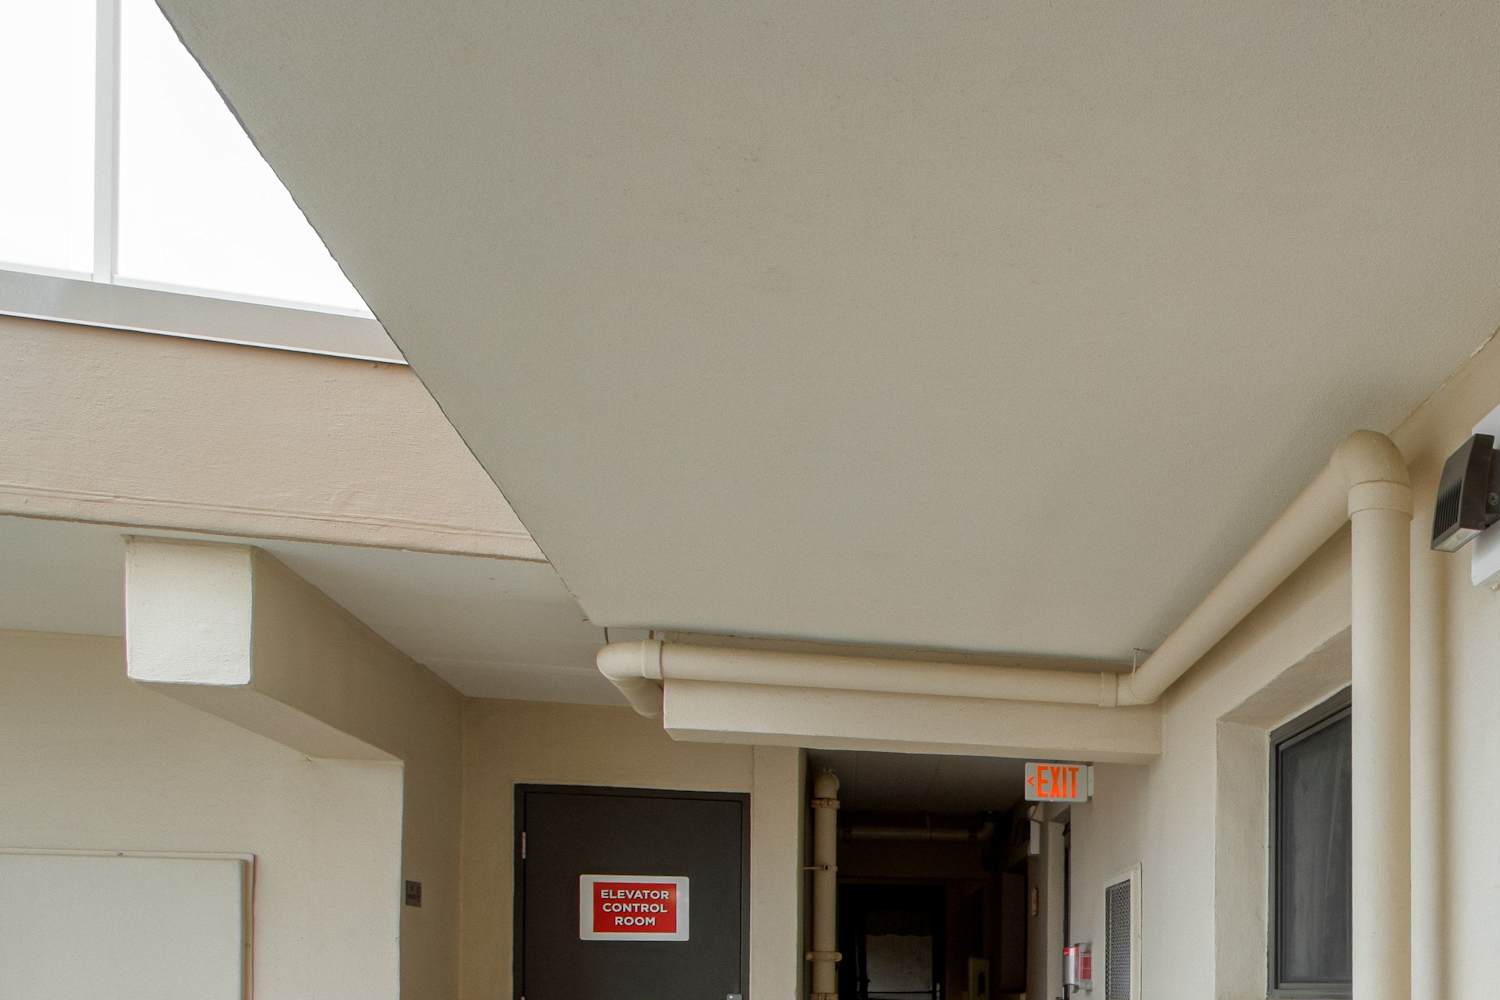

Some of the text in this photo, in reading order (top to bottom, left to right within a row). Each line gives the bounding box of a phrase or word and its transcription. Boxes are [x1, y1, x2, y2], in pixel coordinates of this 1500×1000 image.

[1037, 765, 1079, 799] EXIT
[600, 889, 670, 900] ELEVATOR
[602, 903, 668, 913] CONTROL
[615, 916, 656, 926] ROOM
